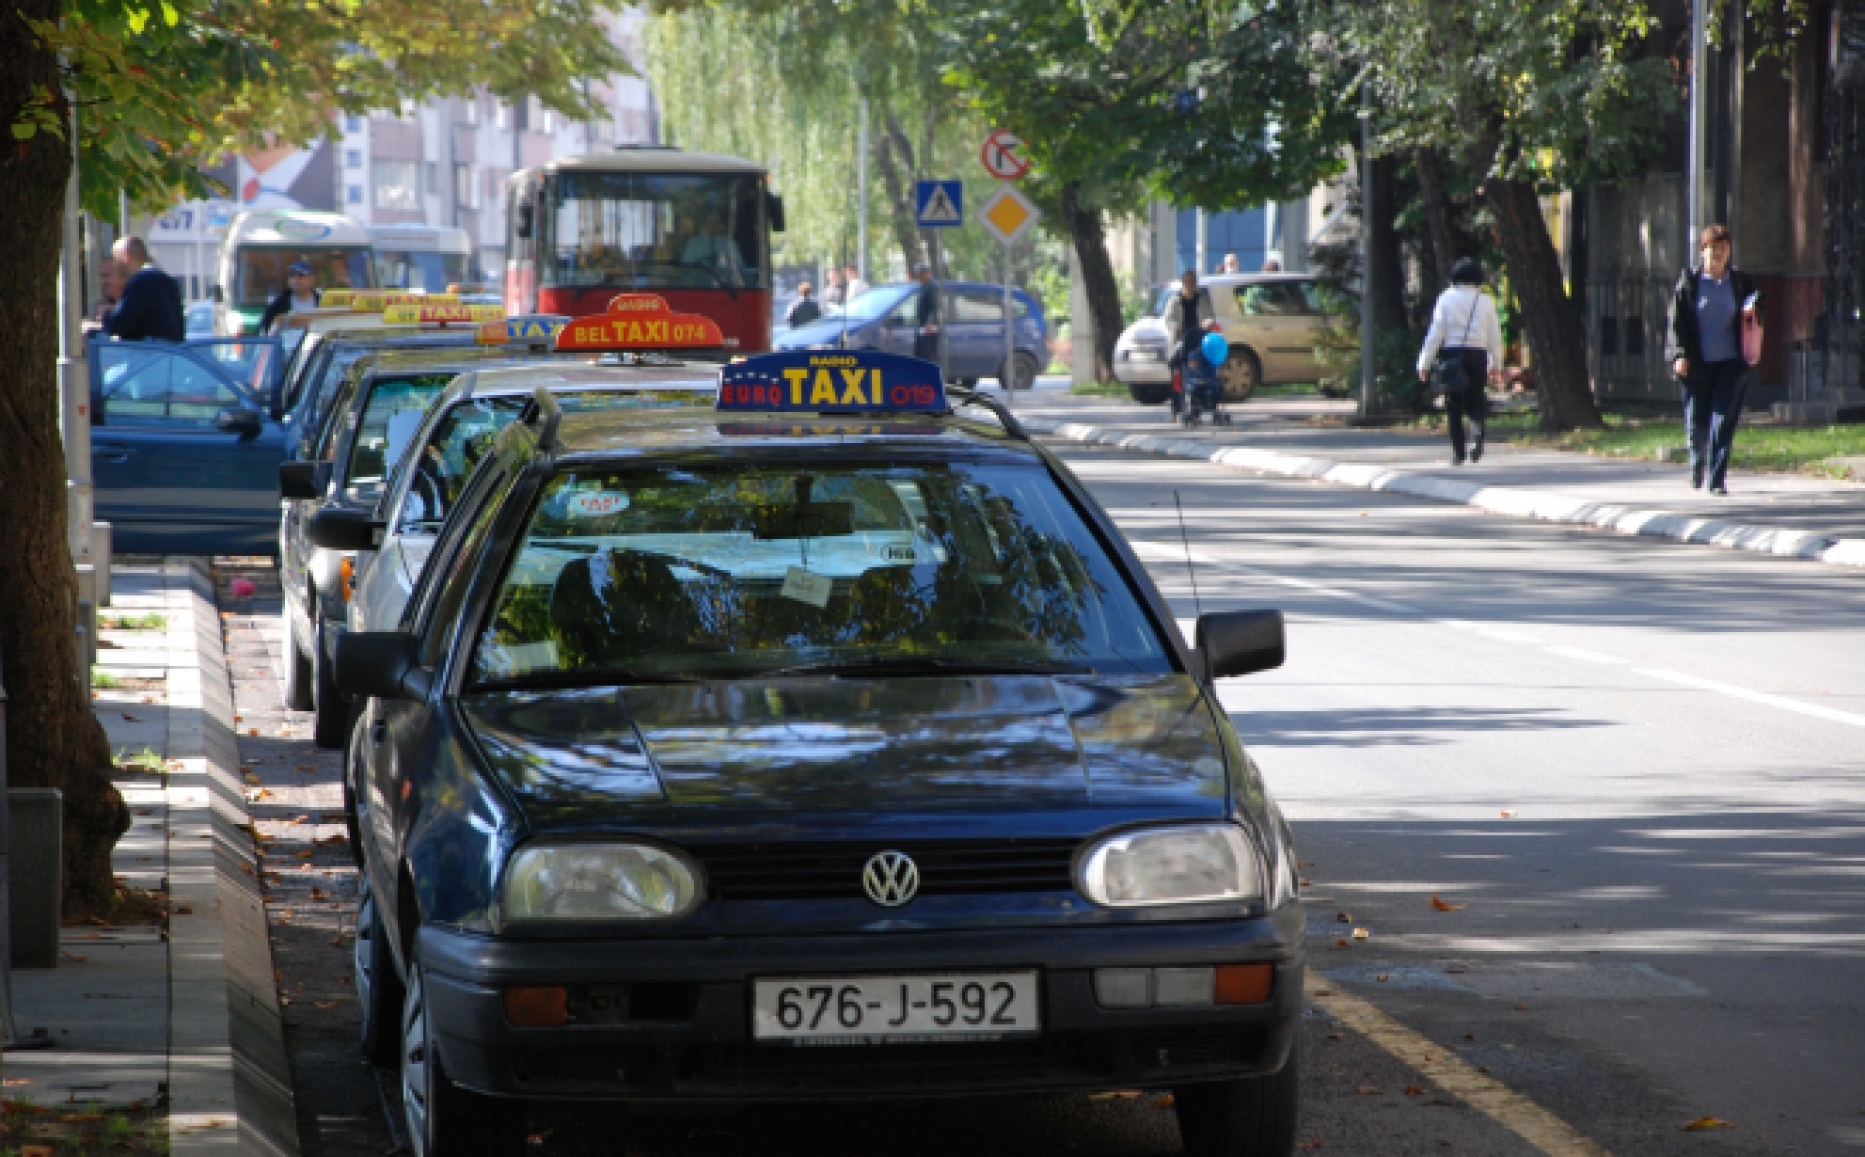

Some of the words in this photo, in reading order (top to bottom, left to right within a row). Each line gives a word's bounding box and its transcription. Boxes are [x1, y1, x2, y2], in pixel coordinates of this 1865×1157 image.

[575, 326, 610, 343] BEL
[612, 321, 669, 343] TAXI
[673, 325, 706, 342] 074
[722, 384, 782, 405] EURO
[782, 366, 884, 405] TAXI
[890, 384, 935, 405] 019
[777, 981, 1017, 1030] 676-J-592
